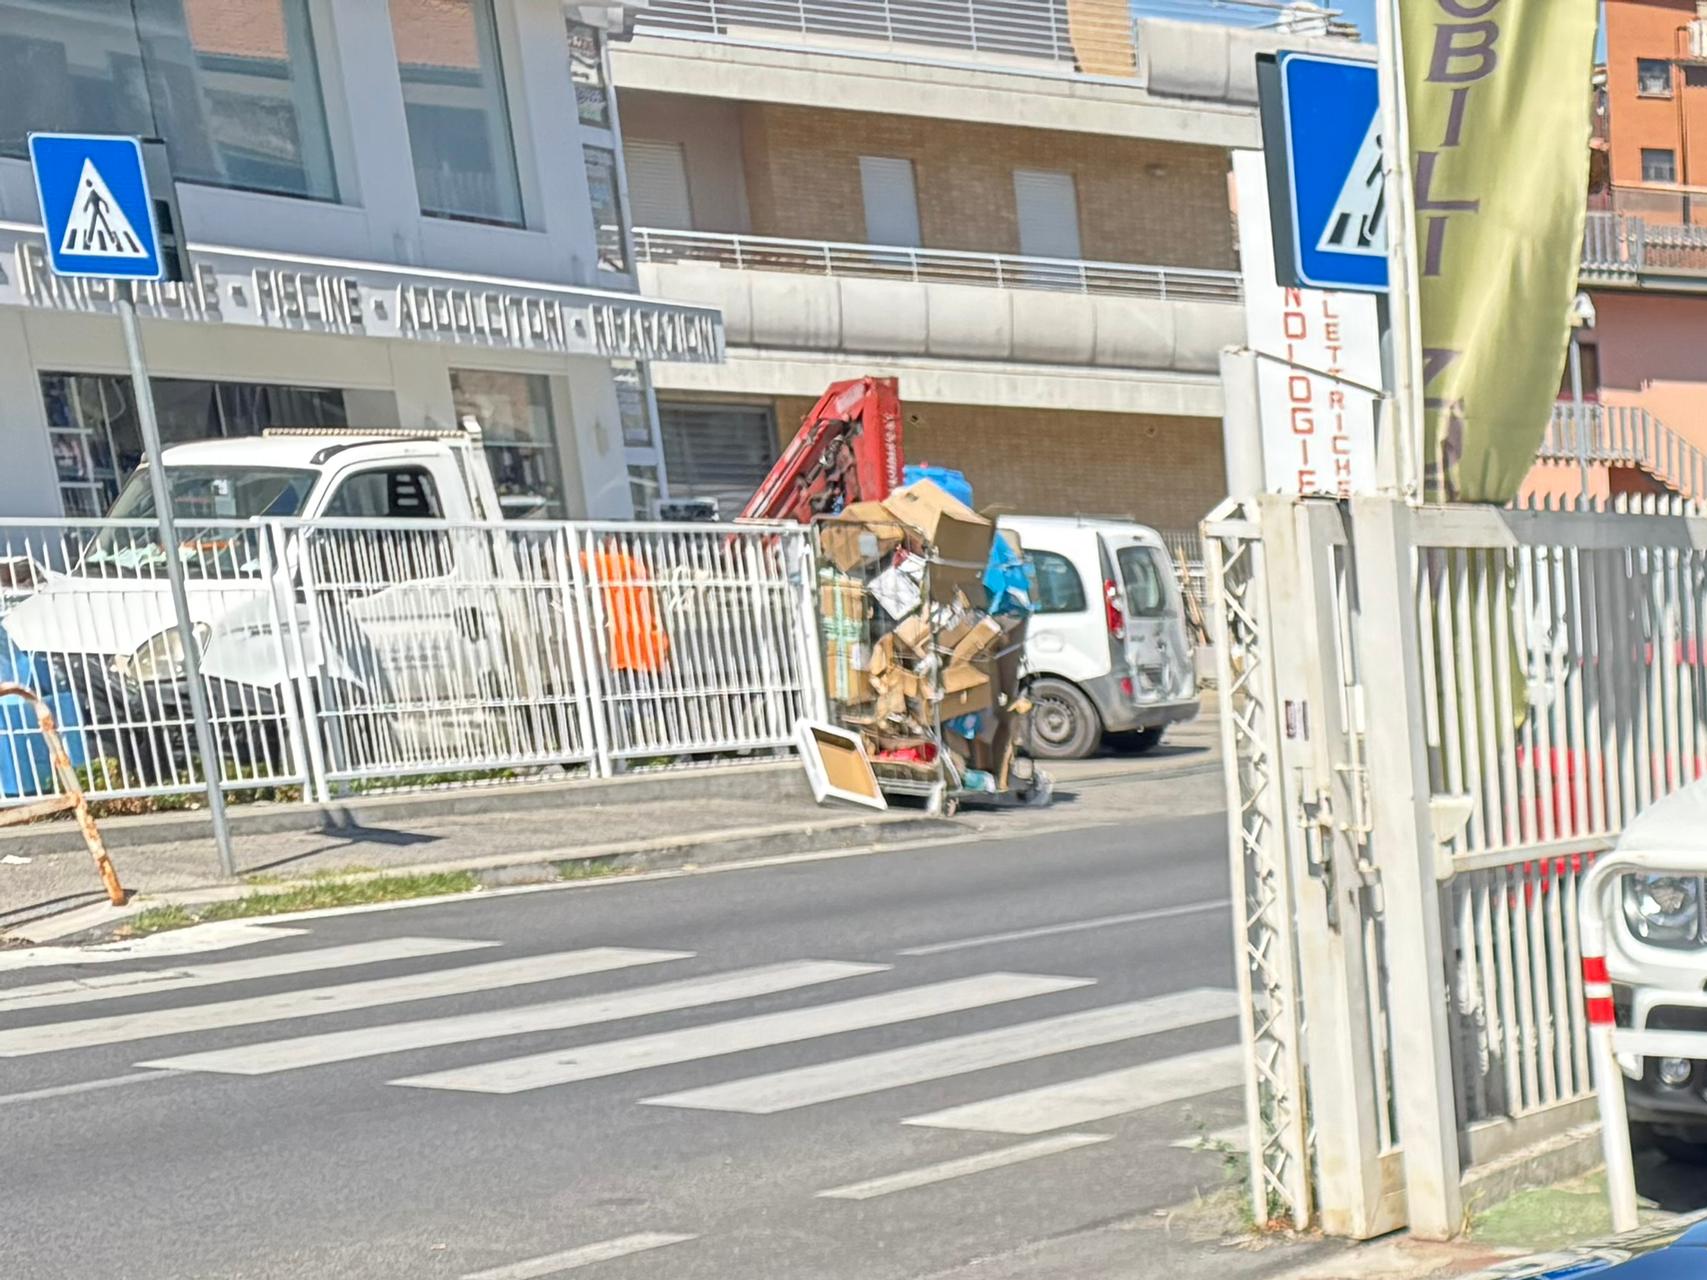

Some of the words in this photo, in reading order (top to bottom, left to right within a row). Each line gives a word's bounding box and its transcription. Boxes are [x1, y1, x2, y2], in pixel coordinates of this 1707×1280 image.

[1414, 0, 1500, 277] BILI
[252, 268, 362, 326] PISCINE
[1284, 287, 1316, 499] NOLOGIE
[1323, 290, 1351, 500] LETTRICHE
